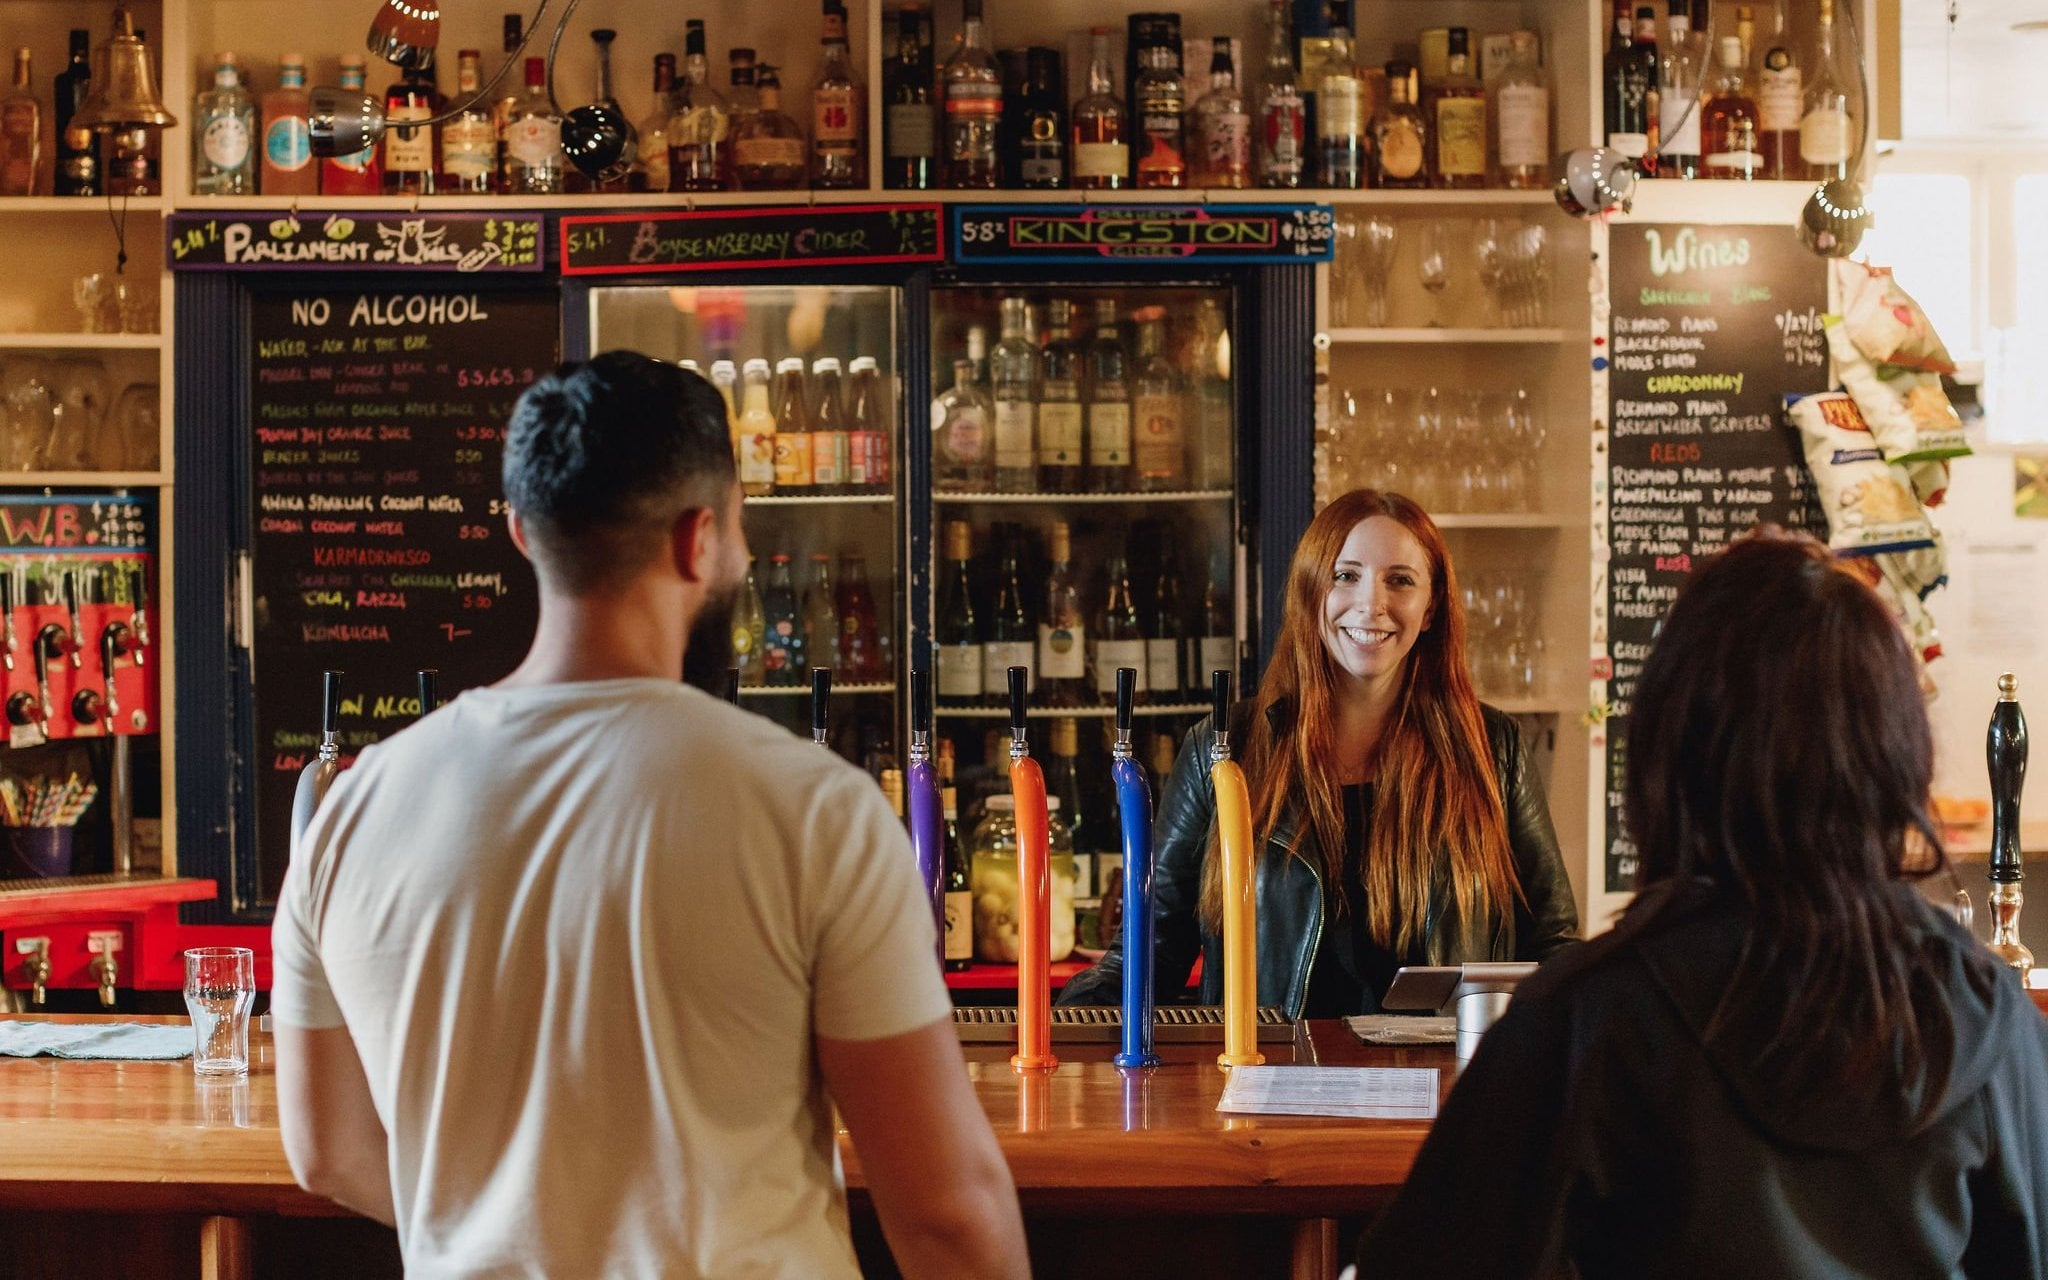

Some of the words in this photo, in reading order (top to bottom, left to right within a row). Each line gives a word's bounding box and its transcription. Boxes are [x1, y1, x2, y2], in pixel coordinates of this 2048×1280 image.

[224, 222, 371, 263] PARLIAMENT
[629, 222, 790, 263] BOYSENBERRY
[794, 228, 869, 253] CIDER
[1015, 221, 1269, 244] KINGSTON
[1645, 228, 1751, 277] Wines
[292, 298, 331, 328] NO
[349, 295, 489, 327] ALCOHOL
[1646, 372, 1744, 395] CHARDONNAY
